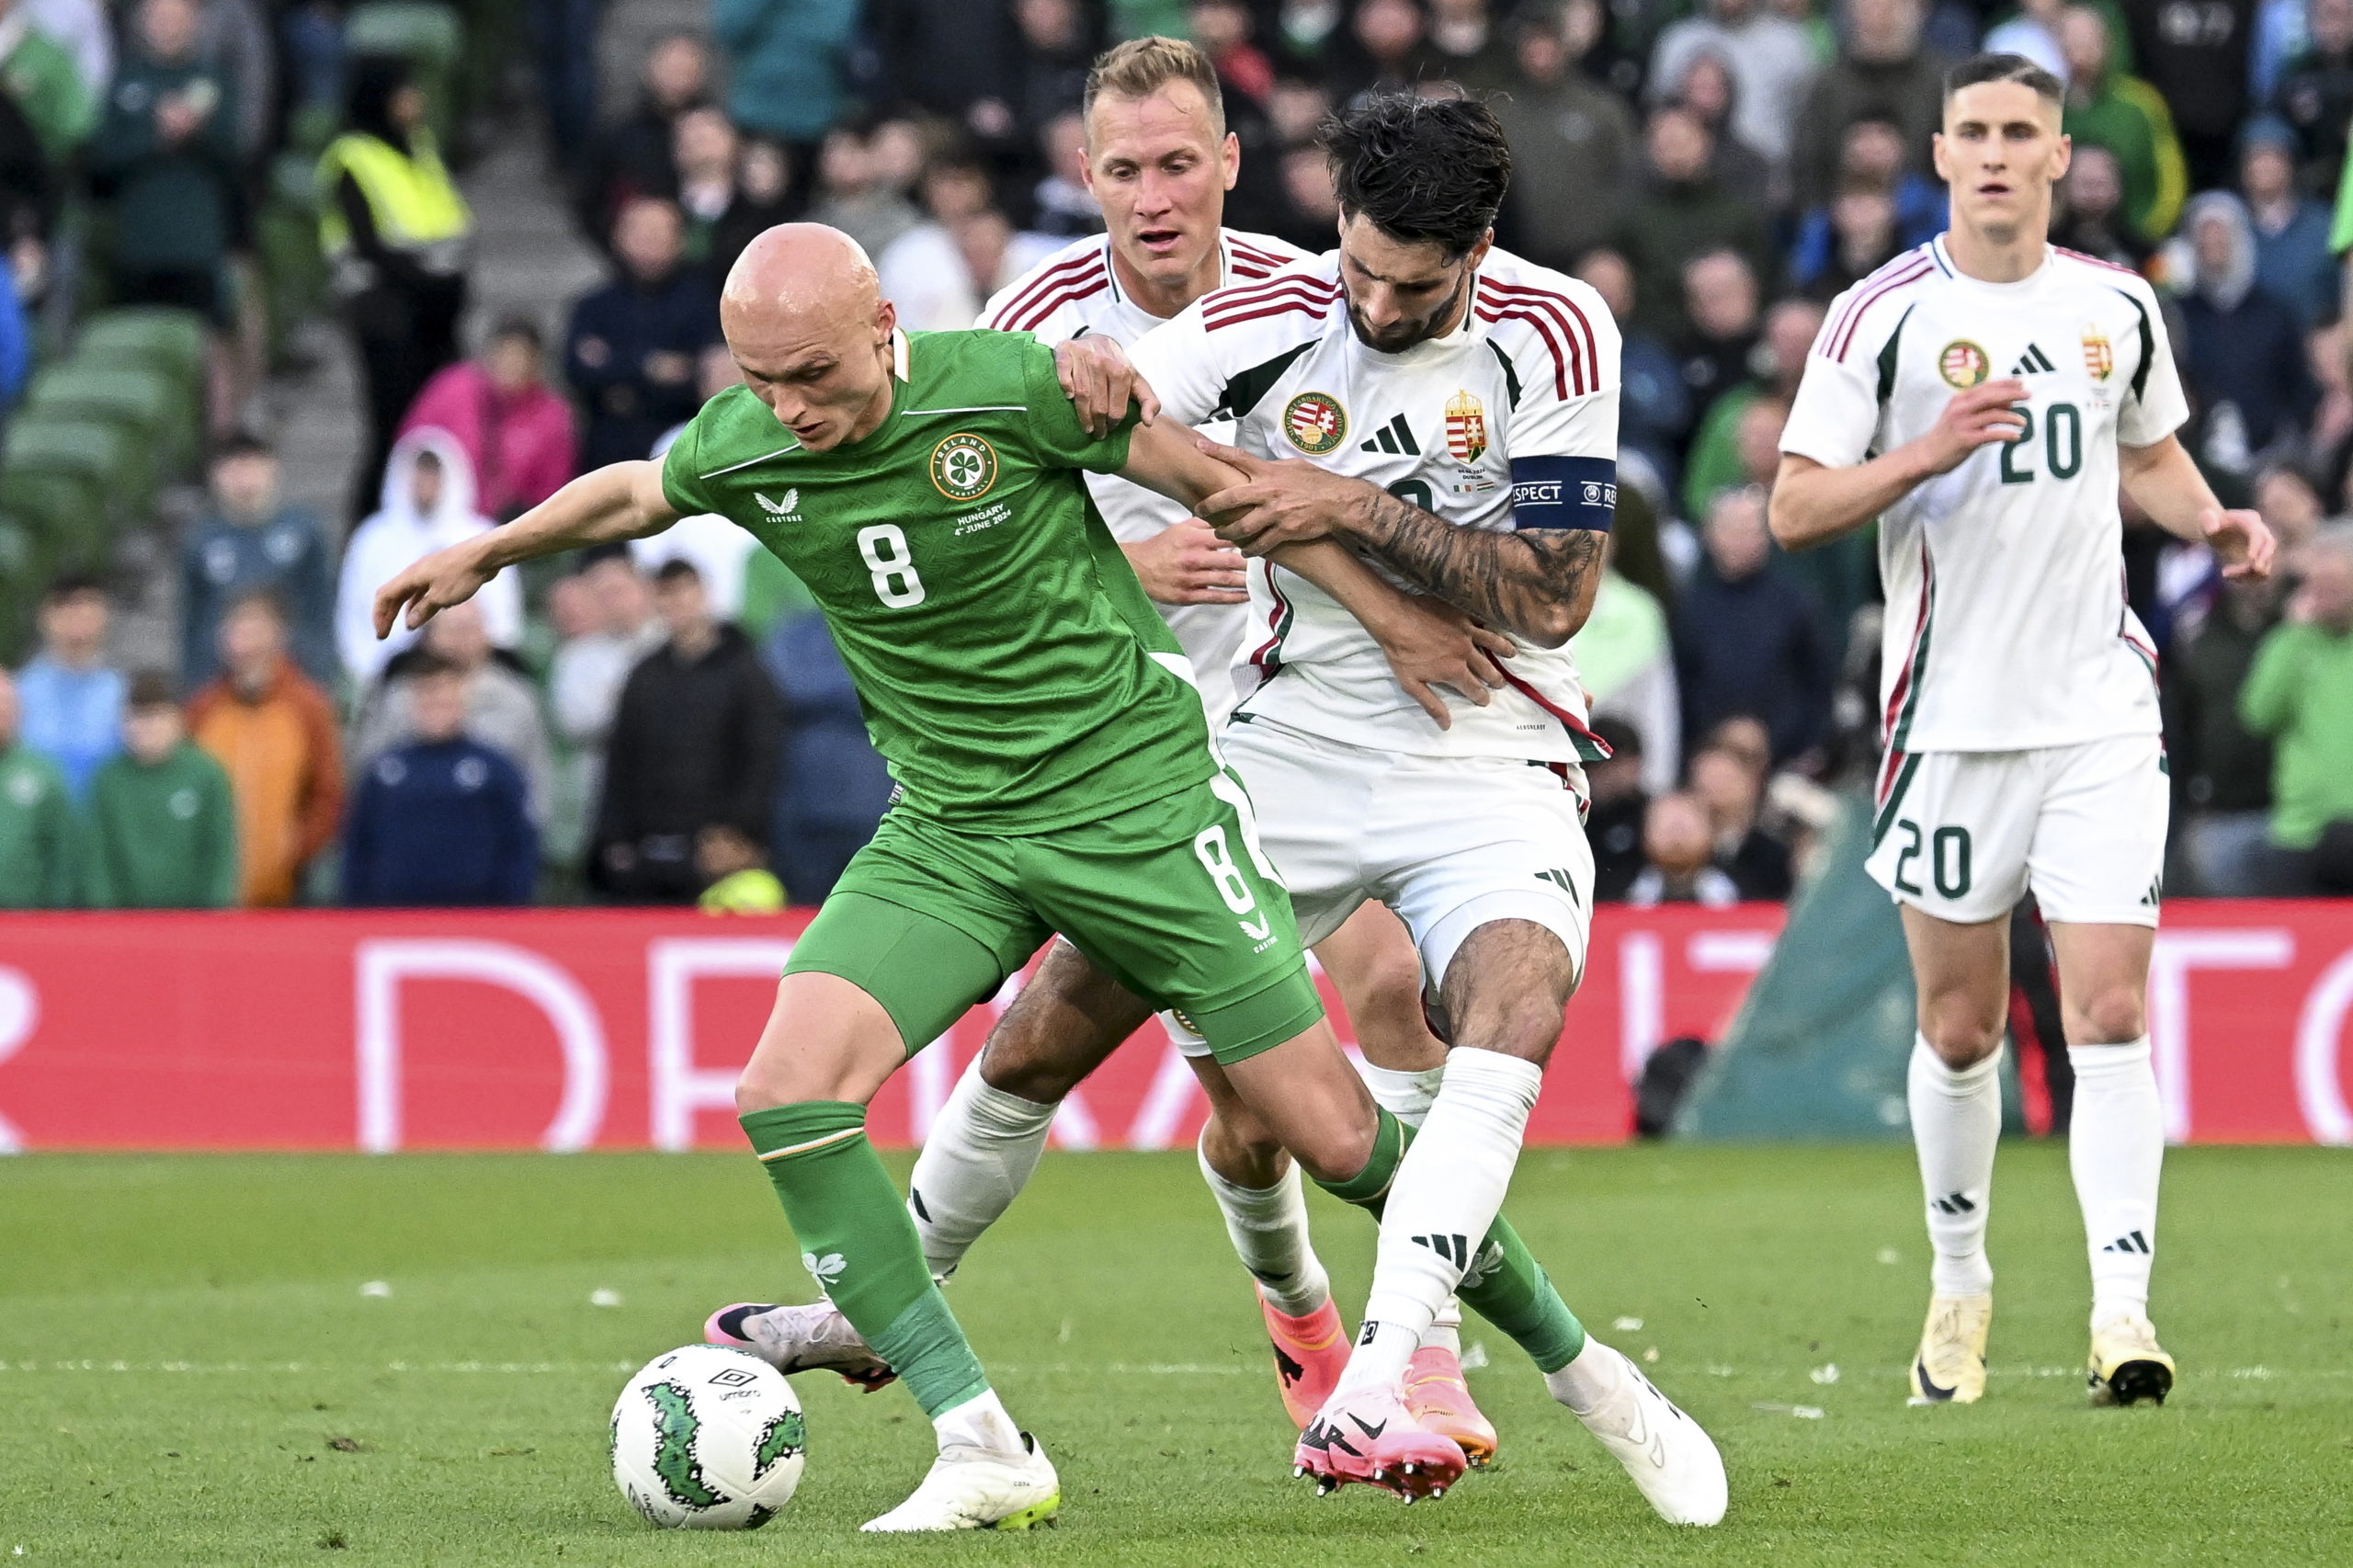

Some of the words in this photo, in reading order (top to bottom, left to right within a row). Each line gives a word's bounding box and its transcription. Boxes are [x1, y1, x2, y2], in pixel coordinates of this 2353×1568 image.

[935, 437, 986, 464] IRELAND
[2000, 403, 2082, 483] 20
[766, 515, 802, 523] CASTORE
[957, 503, 1004, 526] HUNGARY
[965, 519, 992, 533] JUNE
[993, 508, 1012, 525] 2024
[857, 524, 926, 608] 8
[1194, 824, 1256, 915] 8
[1895, 819, 1971, 899] 20
